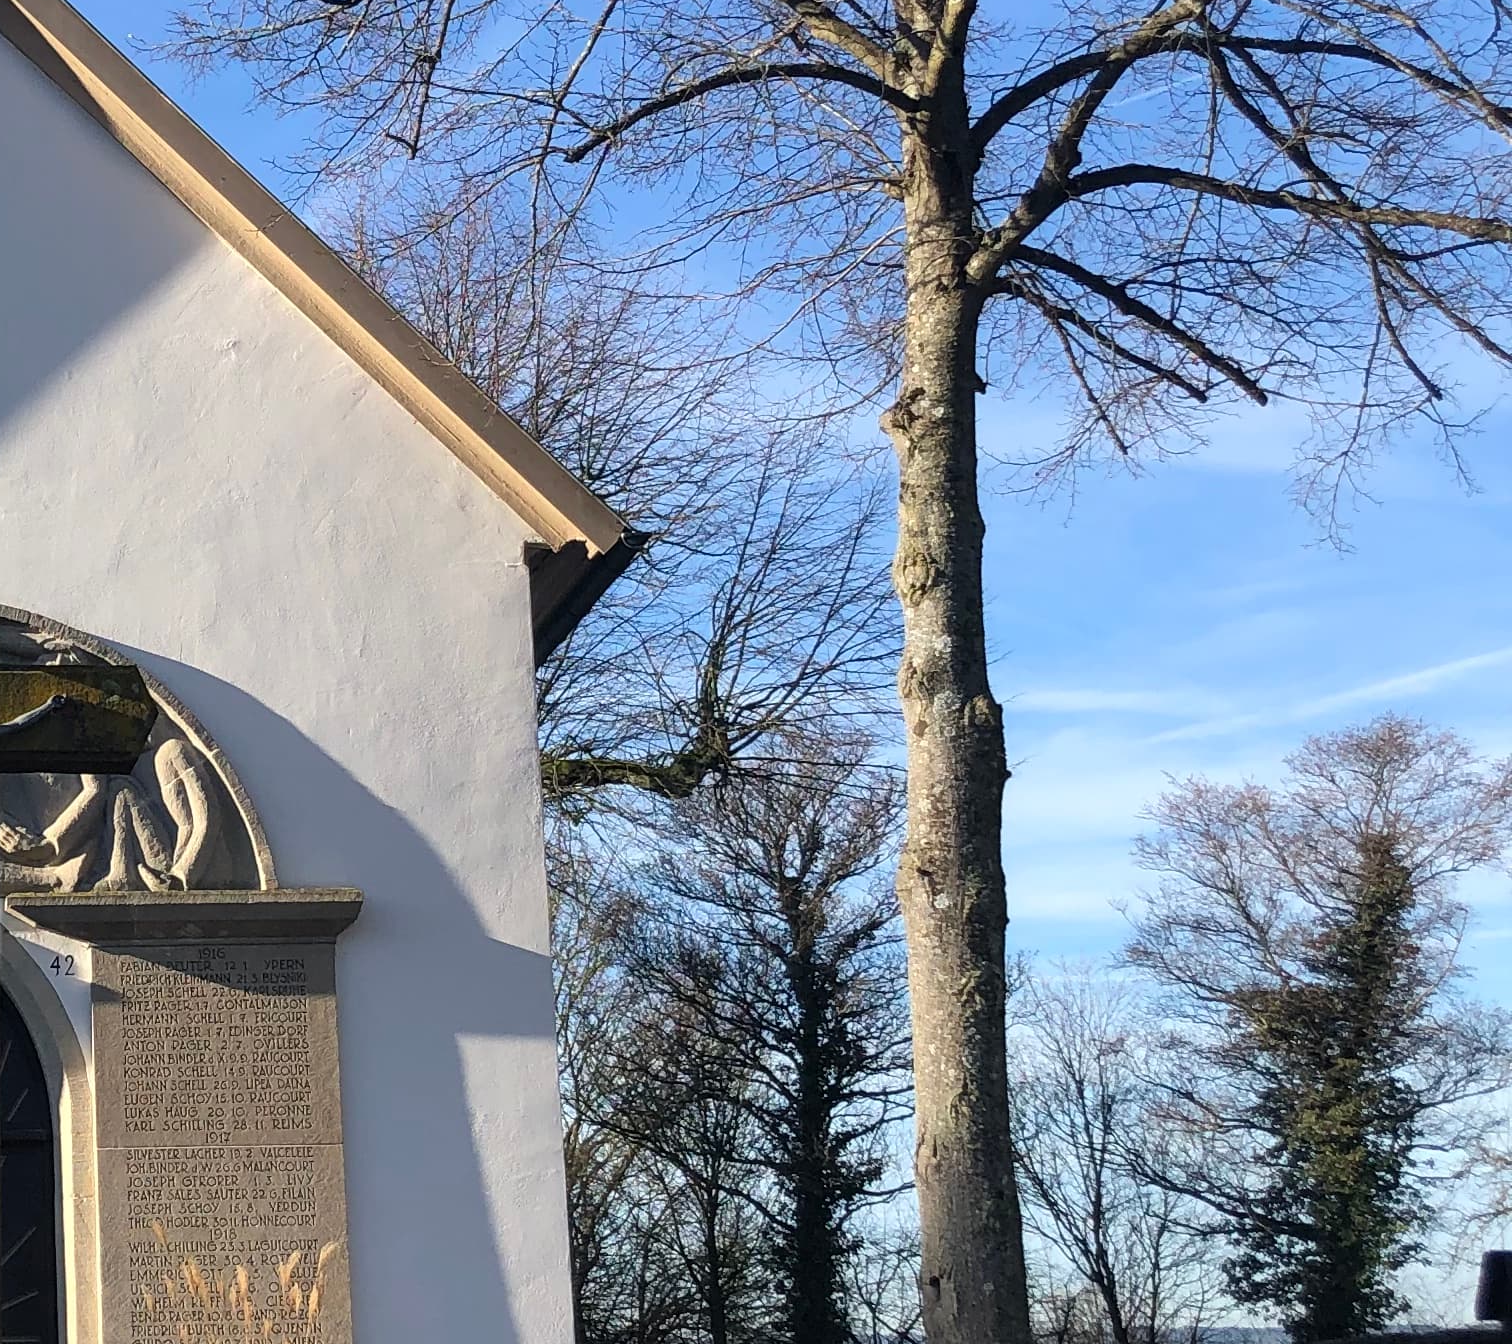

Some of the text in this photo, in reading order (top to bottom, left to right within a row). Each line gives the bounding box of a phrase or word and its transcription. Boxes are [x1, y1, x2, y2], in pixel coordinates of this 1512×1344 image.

[199, 948, 226, 959] 1916
[49, 955, 76, 976] 42
[121, 961, 160, 972] FABIAN
[264, 959, 304, 970] YPERN
[121, 974, 170, 985] FRIEDRICH
[121, 987, 163, 999] JOSEPH
[168, 987, 207, 998] SCHELL
[244, 986, 306, 996] KARLSRUHE
[122, 1001, 150, 1012] FRITZ
[155, 1001, 192, 1012] RAGER
[123, 1014, 179, 1026] HERMANN
[186, 1013, 225, 1024] SCHELL
[255, 1012, 308, 1024] FRICOURT
[122, 1027, 161, 1038] JOSEPH
[166, 1027, 201, 1037] RAGER
[124, 1041, 165, 1051] ANTON
[172, 1040, 212, 1051] RAGER
[253, 1038, 309, 1049] OVILLERS
[123, 1054, 165, 1065] JOHANN
[168, 1054, 207, 1064] BINDER
[253, 1052, 310, 1064] RAUCOURT
[124, 1067, 171, 1078] KONRAD
[178, 1066, 217, 1077] SCHELL
[253, 1065, 310, 1077] RAUCOURT
[124, 1081, 166, 1091] JOHANN
[170, 1080, 207, 1091] SCHELL
[124, 1094, 164, 1105] EUGEN
[170, 1092, 212, 1104] SCHOY
[250, 1091, 312, 1103] RAUCOURT
[124, 1107, 160, 1118] LUKAS
[165, 1106, 198, 1117] HAUG
[126, 1121, 155, 1132] KARL
[162, 1120, 225, 1131] SCHILLING
[272, 1118, 313, 1130] REIMS
[206, 1132, 232, 1144] 1917
[126, 1148, 226, 1161] SILVESTER LACHER
[243, 1160, 315, 1172] MALANCOURT
[128, 1176, 175, 1188] JOSEPH
[287, 1174, 314, 1186] LIVY
[127, 1189, 163, 1201] FRANZ
[167, 1189, 202, 1200] SALES
[207, 1188, 249, 1200] SAUTER
[282, 1187, 315, 1199] FILAIN
[128, 1204, 172, 1215] JOSEPH
[179, 1203, 220, 1214] SCHOY
[269, 1201, 316, 1212] VERDUN
[167, 1216, 209, 1228] HODLER
[242, 1215, 316, 1228] HONNECOURT
[210, 1229, 237, 1240] 1918
[130, 1256, 172, 1268] MARTIN
